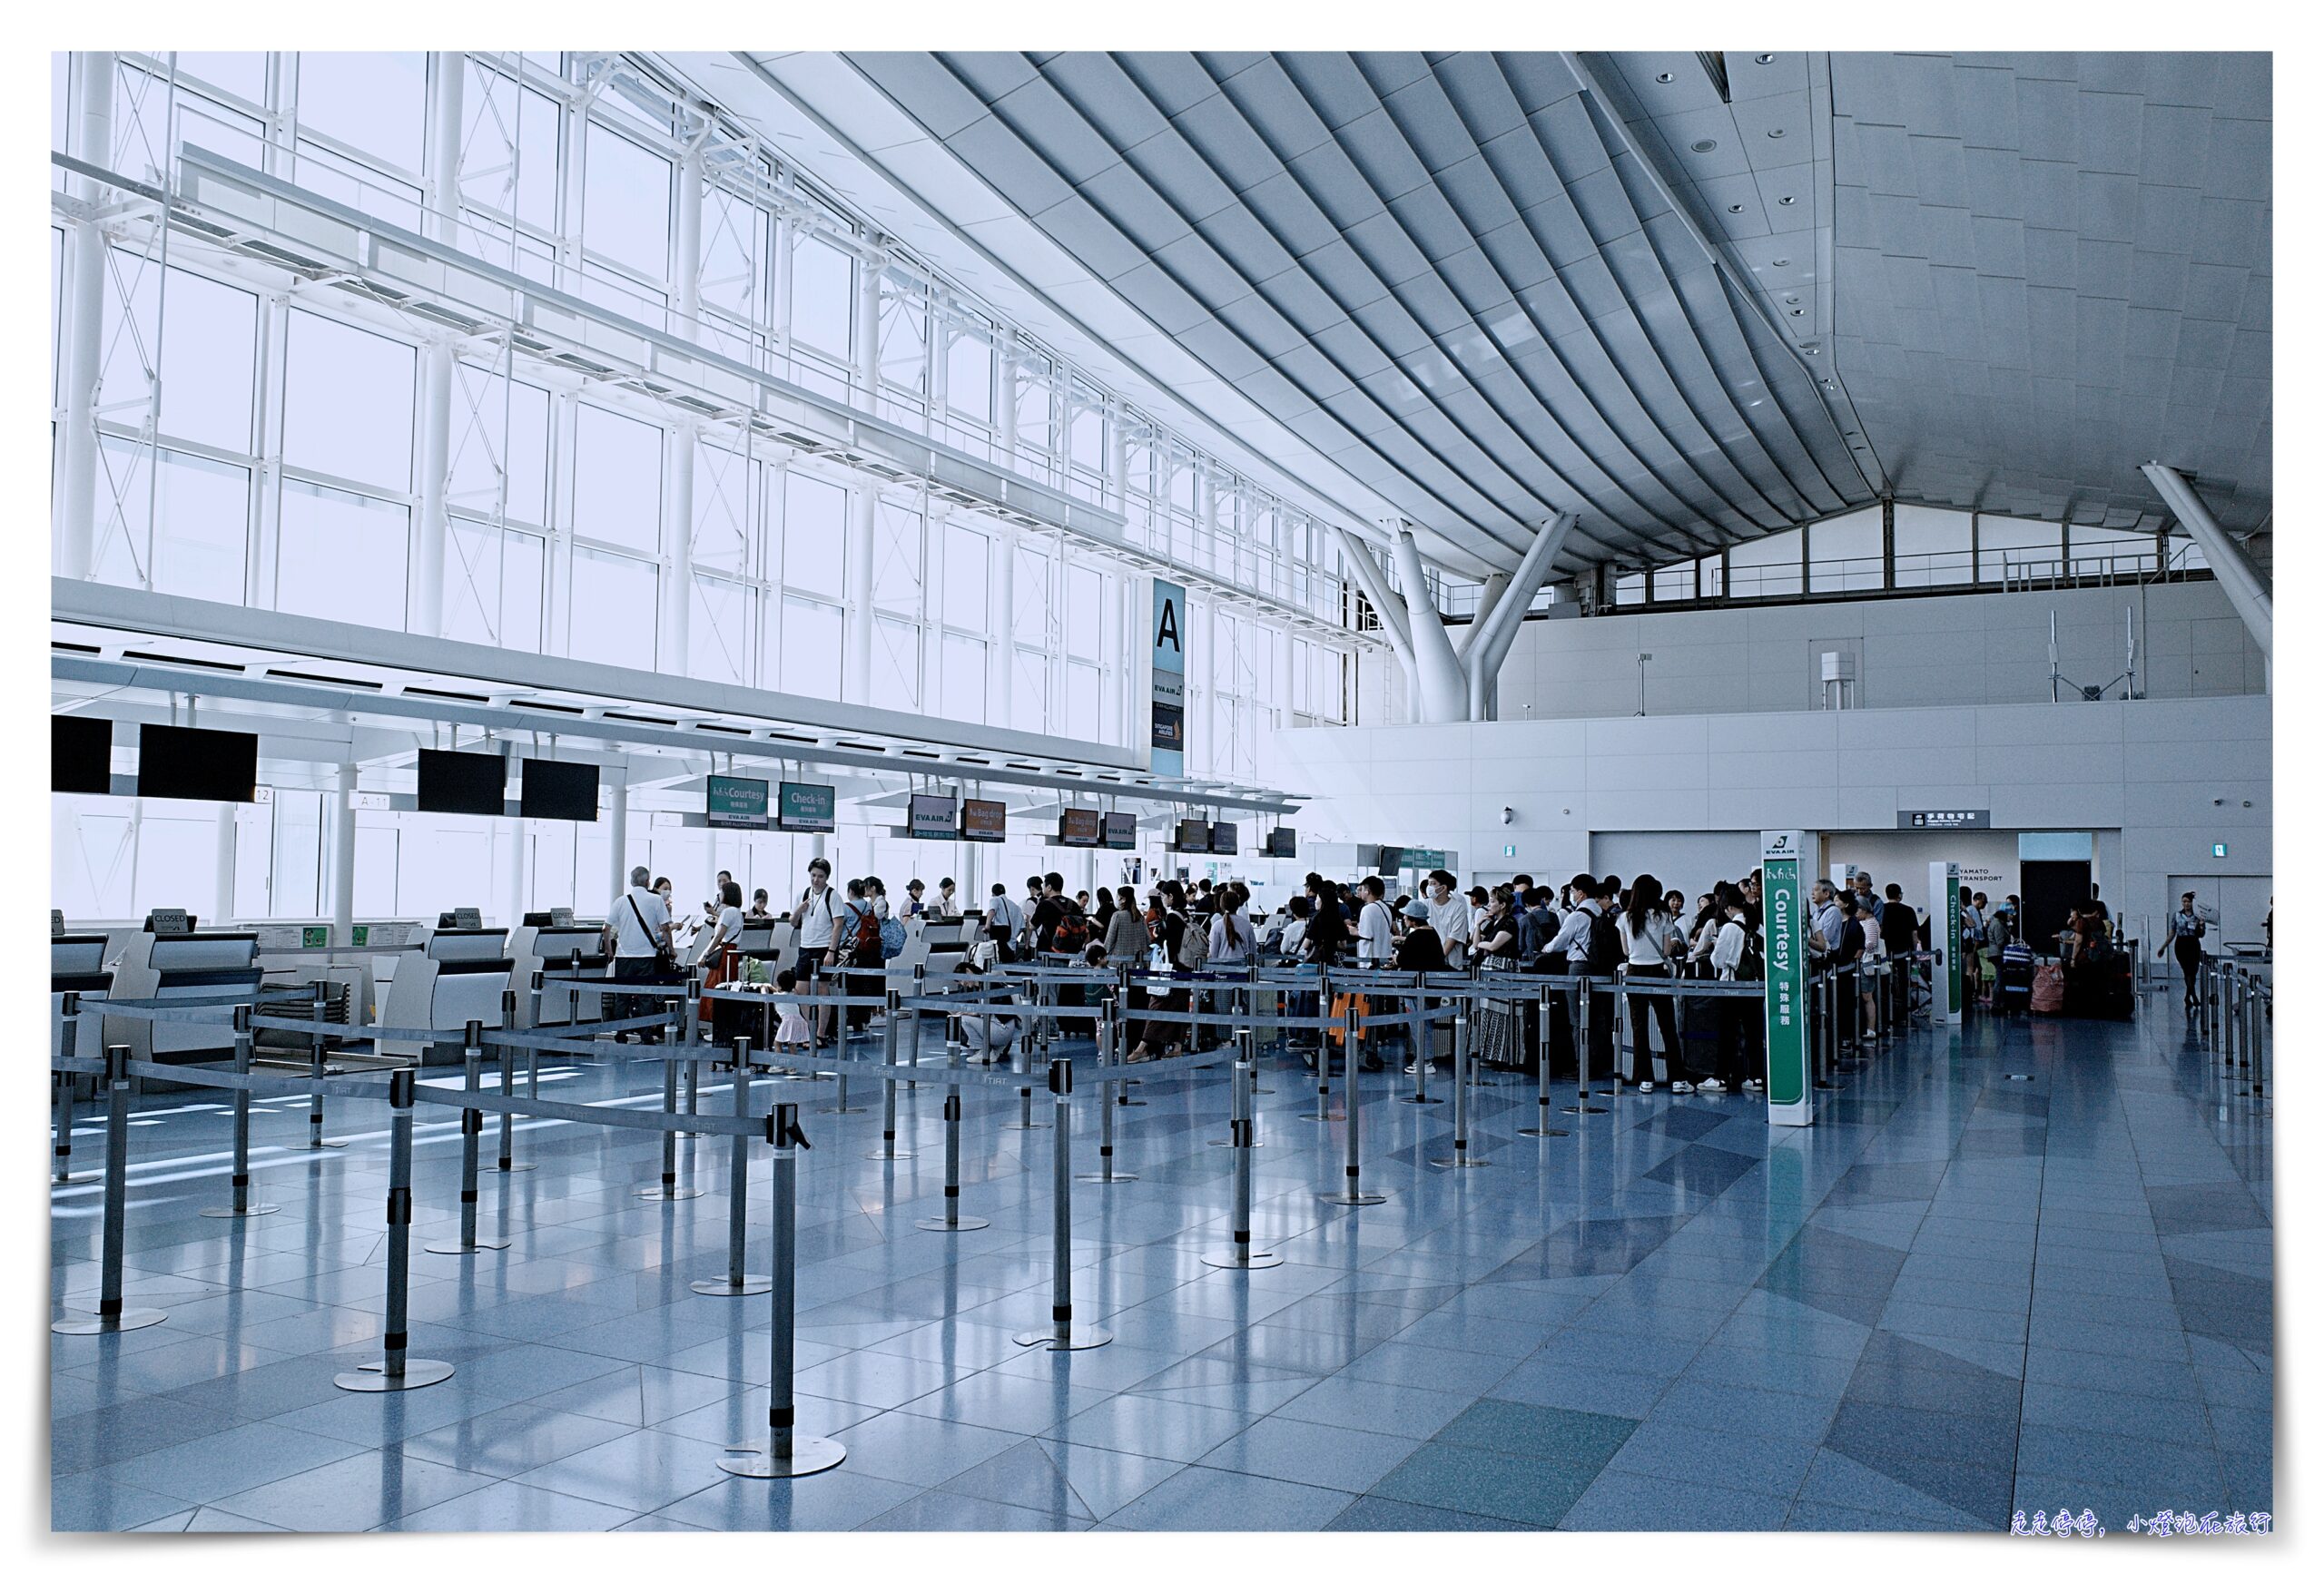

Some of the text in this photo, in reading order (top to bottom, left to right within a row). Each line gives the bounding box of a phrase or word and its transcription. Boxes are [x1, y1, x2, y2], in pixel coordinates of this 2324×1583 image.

[1157, 598, 1180, 653] A
[1155, 684, 1176, 695] EVA AIR
[257, 790, 270, 801] 12
[729, 787, 764, 802] Courtesy
[792, 792, 826, 805] Check-in
[915, 813, 931, 821] EVA
[154, 914, 186, 922] CLOSED
[1950, 894, 1958, 939] Check-in
[1773, 889, 1790, 971] Courtesy
[1778, 980, 1790, 1026] 特殊服務
